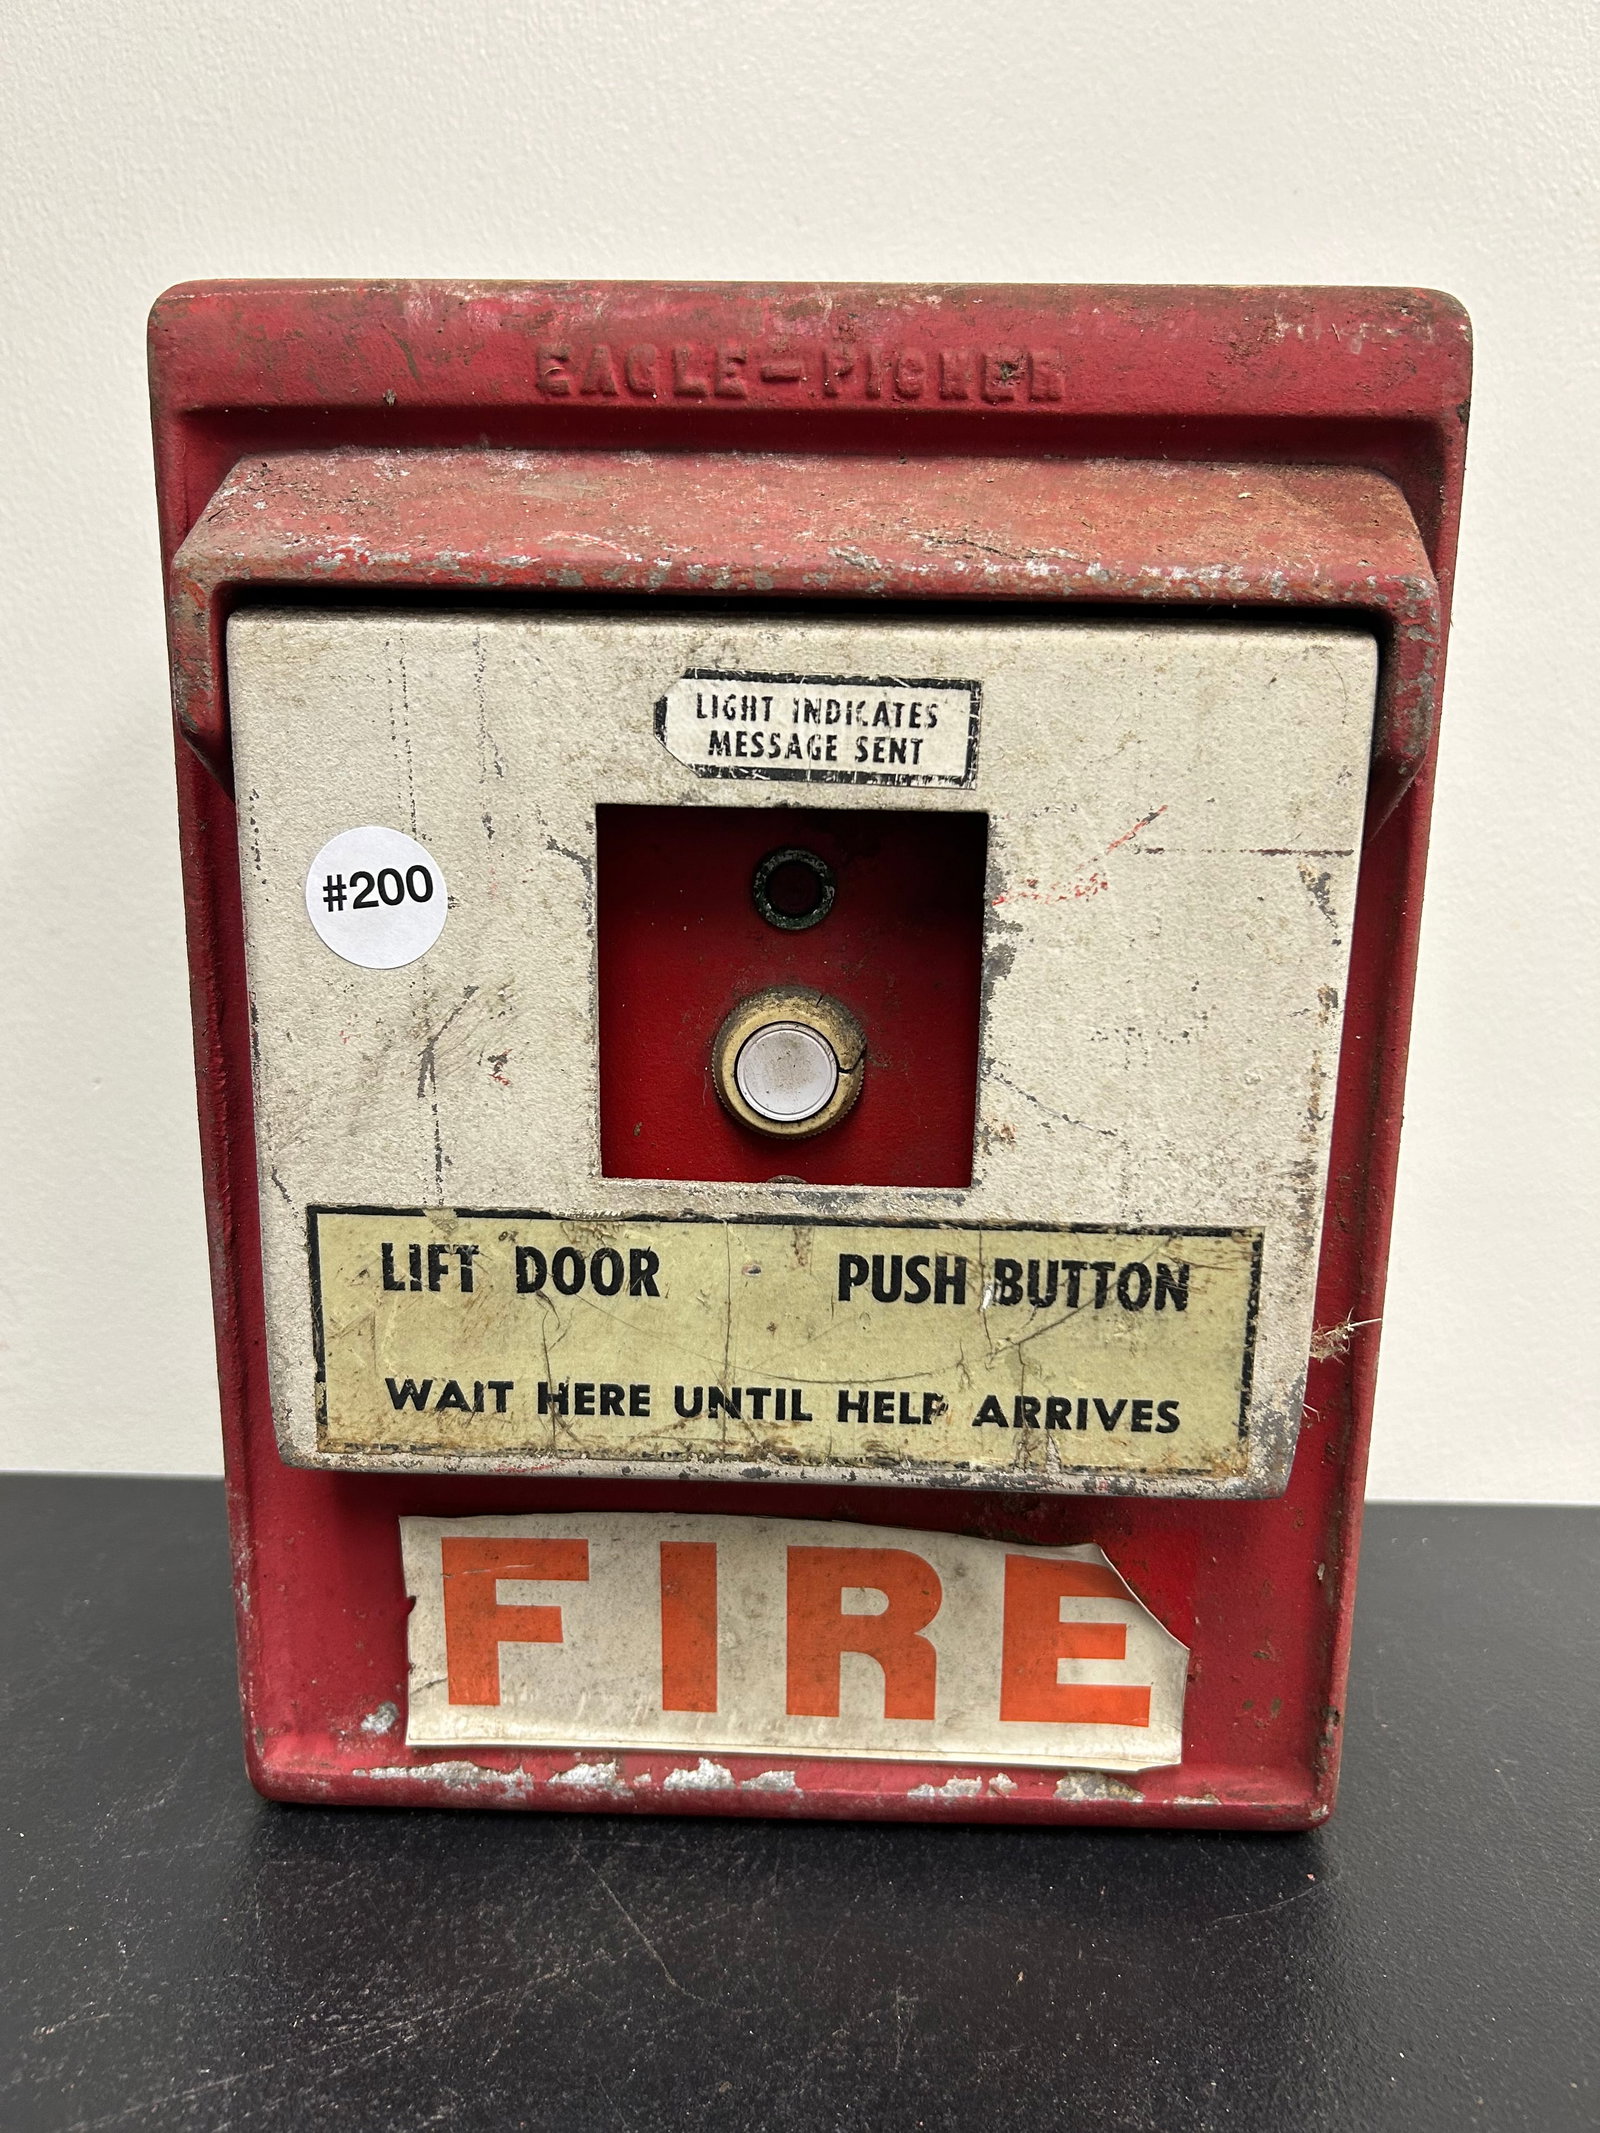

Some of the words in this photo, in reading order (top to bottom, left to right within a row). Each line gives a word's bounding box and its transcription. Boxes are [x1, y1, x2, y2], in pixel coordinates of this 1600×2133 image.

[696, 692, 774, 721] LIGHT
[792, 697, 938, 729] INDICATES
[708, 730, 838, 762] MESSAGE
[854, 736, 923, 765] SENT
[322, 864, 434, 912] #200
[381, 1242, 479, 1293] LIFT
[515, 1245, 660, 1297] DOOR
[838, 1253, 967, 1305] PUSH
[993, 1258, 1190, 1312] BUTTON
[385, 1377, 514, 1413] WAIT
[537, 1380, 651, 1417] HERE
[674, 1385, 812, 1422] UNTIL
[837, 1388, 949, 1425] HELP
[971, 1394, 1180, 1433] ARRIVES
[441, 1536, 1151, 1728] FIRE
